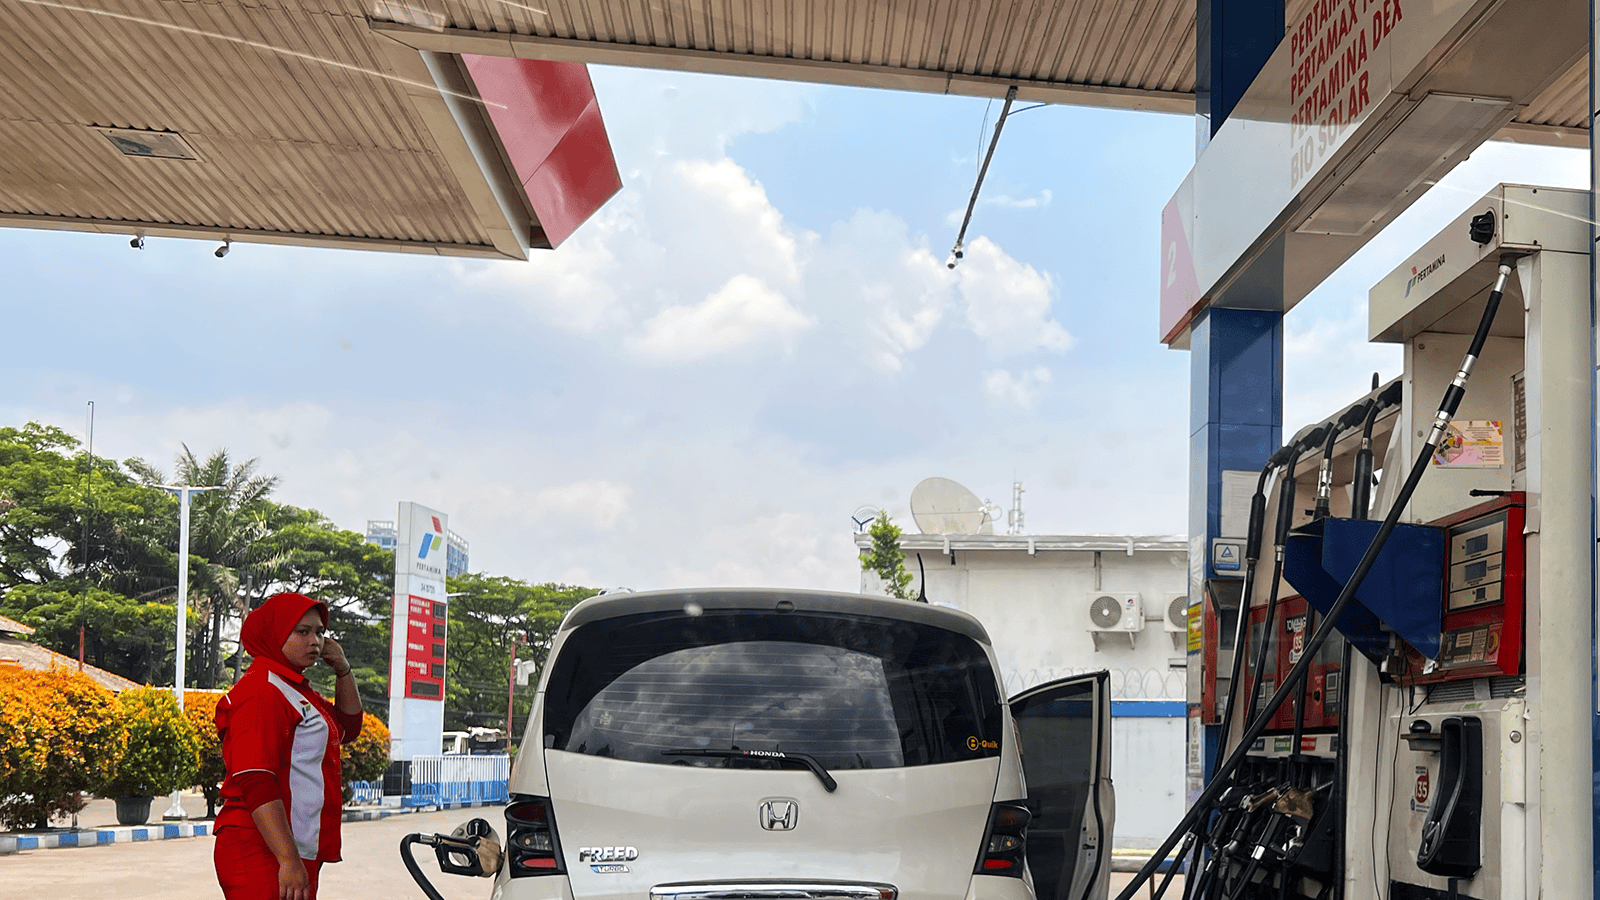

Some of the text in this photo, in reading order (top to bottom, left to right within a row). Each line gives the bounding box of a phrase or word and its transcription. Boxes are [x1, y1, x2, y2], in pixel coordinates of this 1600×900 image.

[1291, 0, 1358, 107] PERTAMAX
[1291, 0, 1402, 149] PERTAMINA DEX
[1291, 70, 1370, 190] BIO SOLAR
[1166, 240, 1177, 290] 2
[1417, 253, 1446, 284] PERTAMINA
[750, 750, 786, 758] HONDA
[579, 846, 640, 863] FREED
